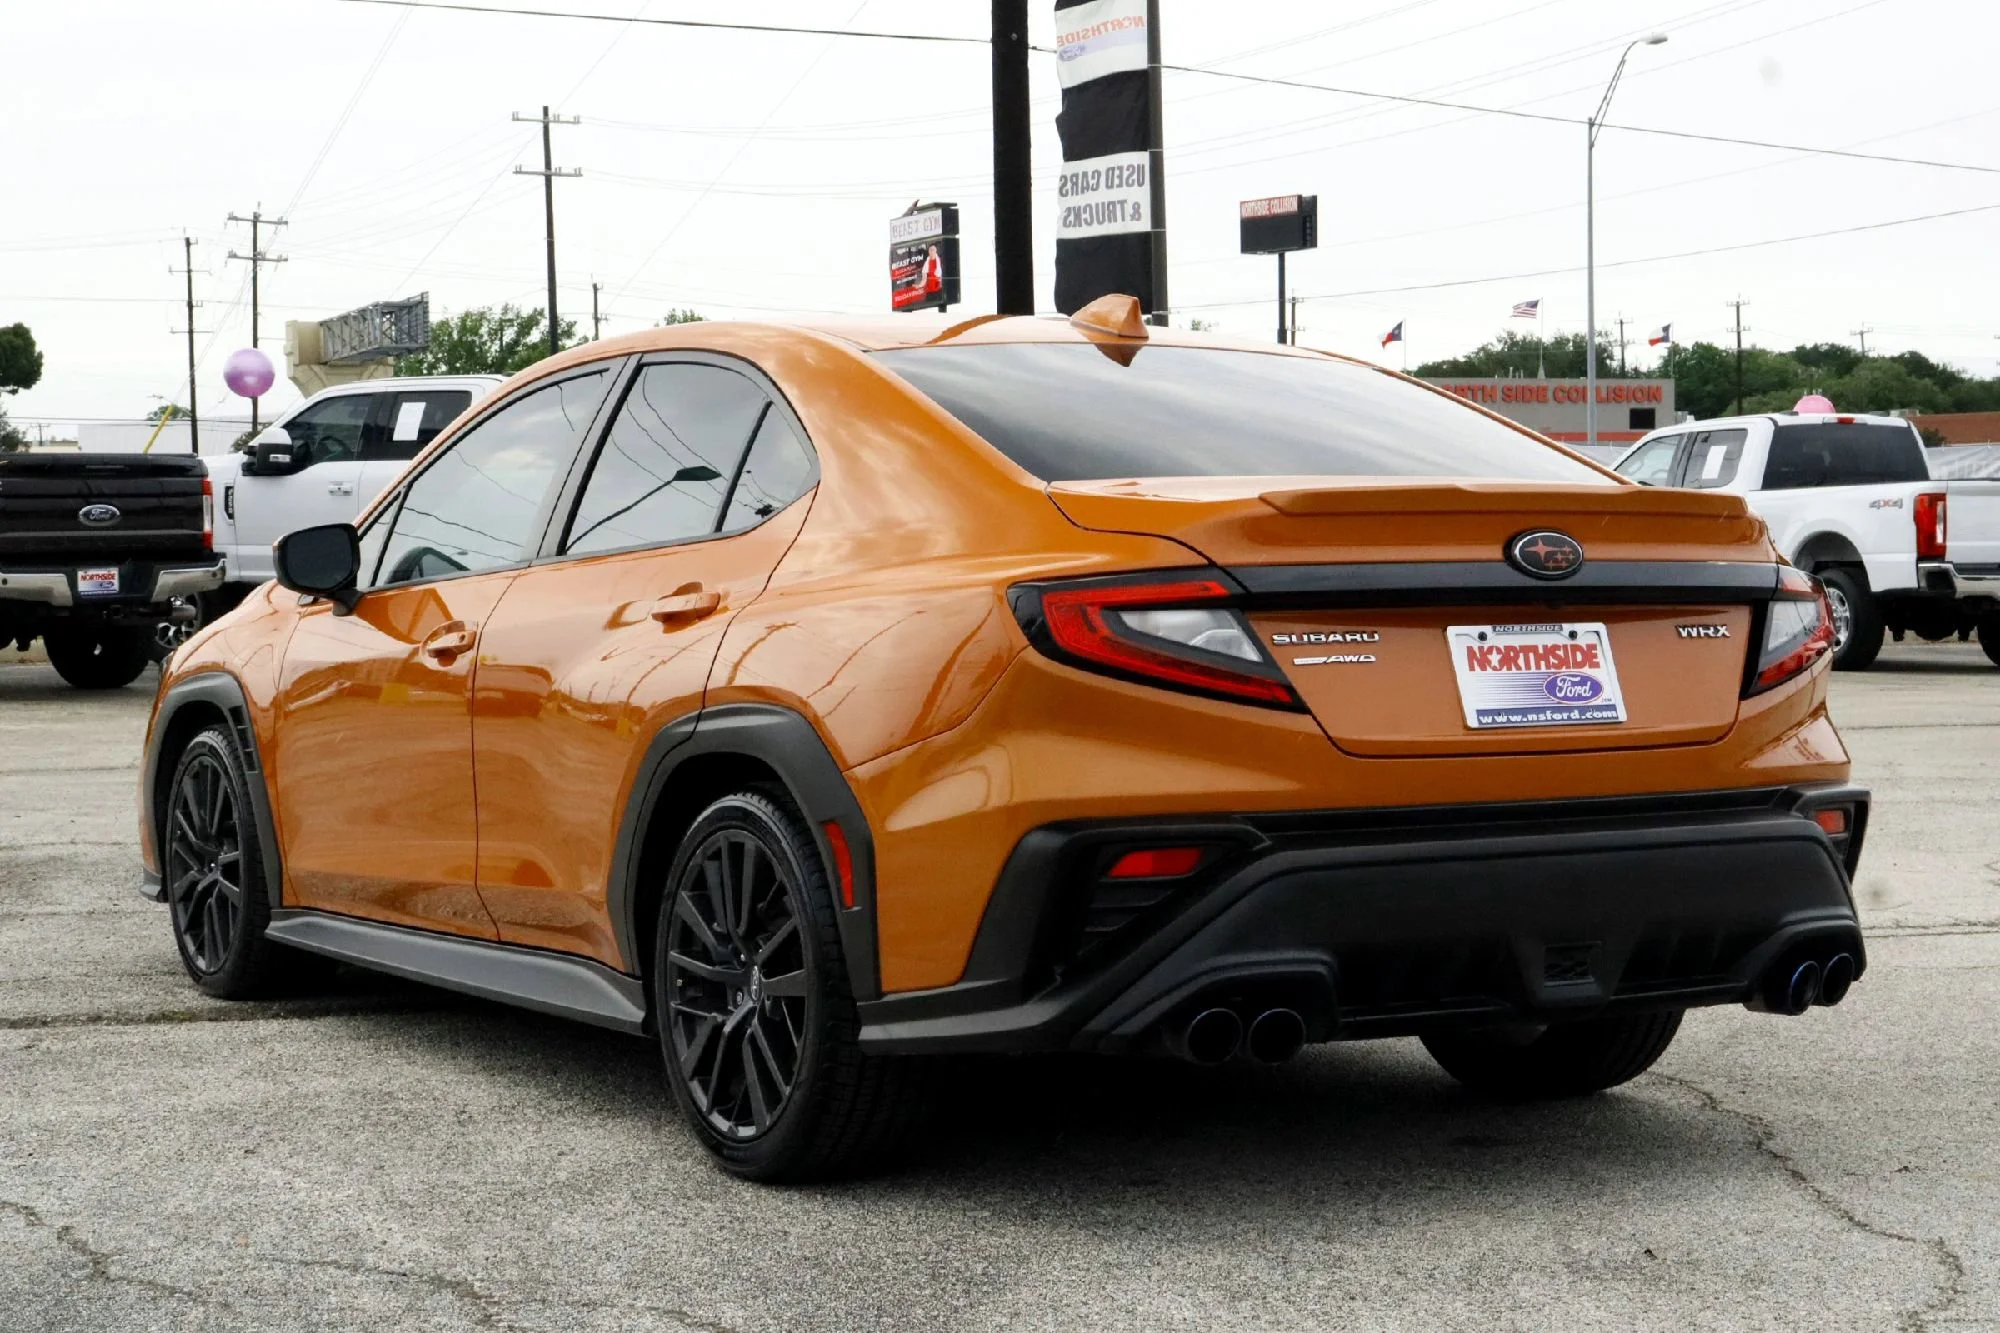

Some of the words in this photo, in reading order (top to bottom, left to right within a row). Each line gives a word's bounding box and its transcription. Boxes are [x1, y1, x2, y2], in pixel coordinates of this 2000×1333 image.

[892, 219, 919, 238] BEAST
[923, 215, 941, 232] GYM
[1502, 384, 1548, 403] SIDE
[80, 573, 116, 581] NORTHSIDE
[1495, 624, 1562, 633] NORTHSIDE
[1677, 624, 1731, 638] WRX
[1271, 632, 1380, 645] SUBARU
[1326, 654, 1377, 663] AWD
[1466, 644, 1601, 672] NORTHSIDE
[1556, 675, 1593, 697] Ford
[1478, 709, 1618, 724] www.nsford.com
